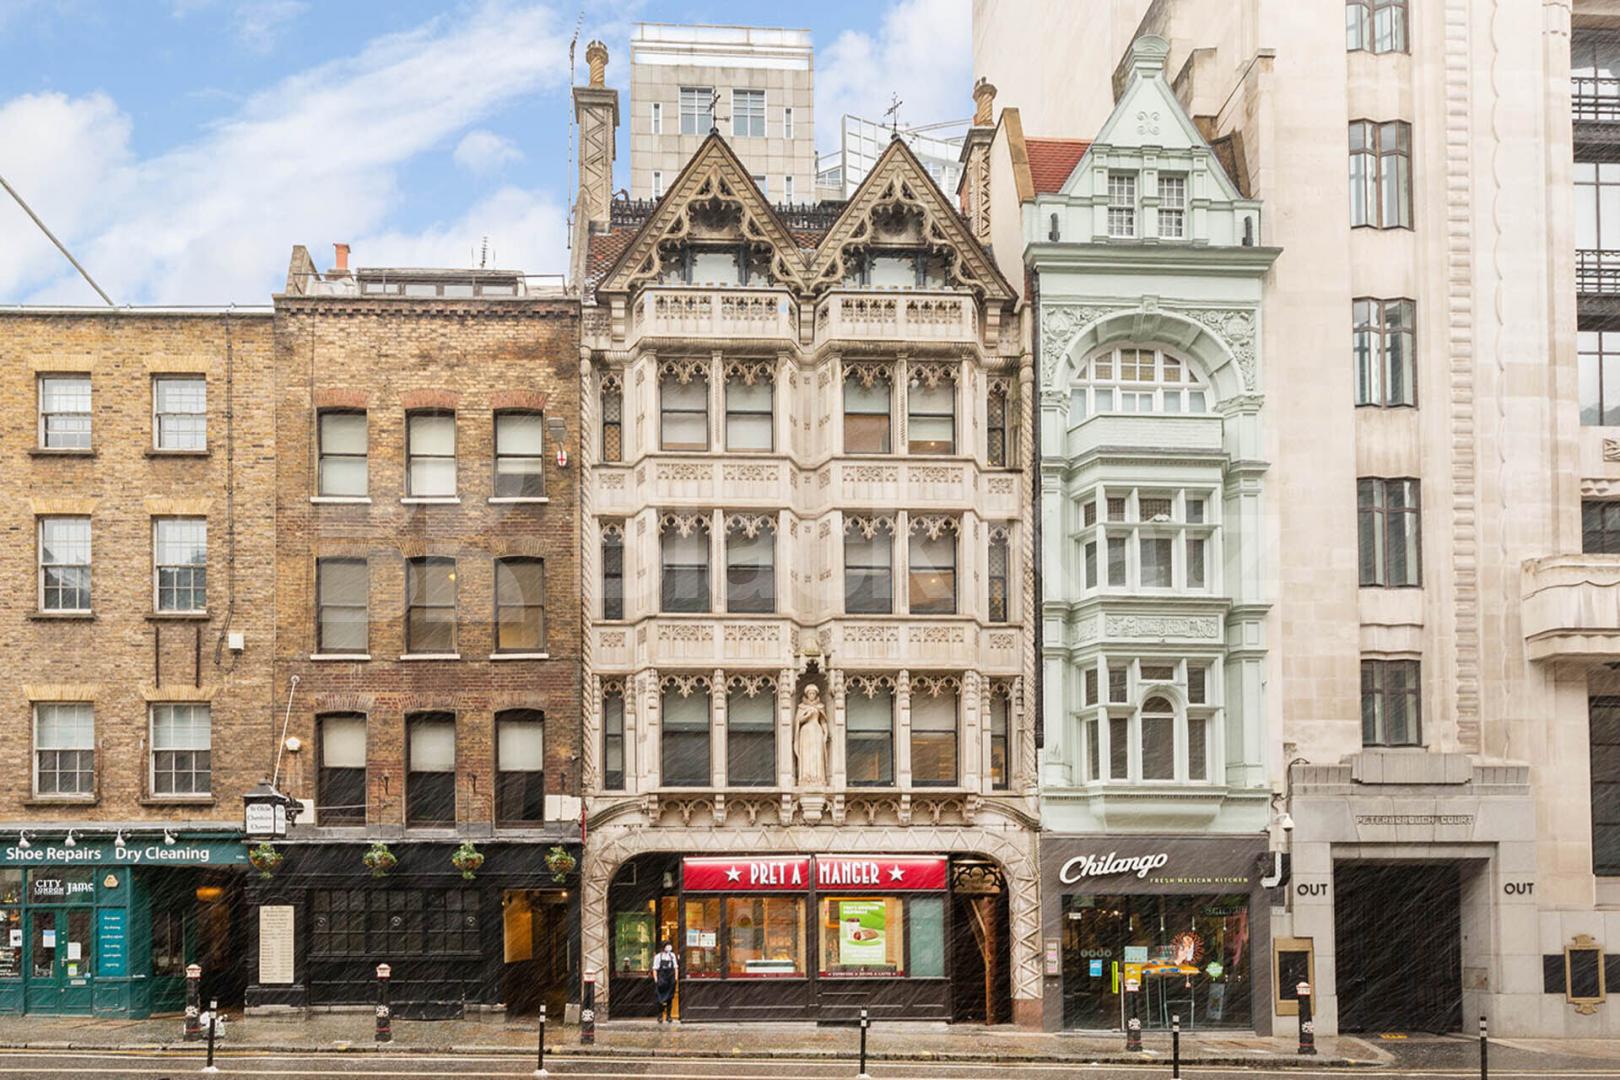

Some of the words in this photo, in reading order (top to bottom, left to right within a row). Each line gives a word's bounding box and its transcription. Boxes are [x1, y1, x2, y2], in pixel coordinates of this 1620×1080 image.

[1355, 815, 1435, 825] PETERBOROUGH
[1440, 815, 1473, 825] COURT
[6, 847, 43, 860] Shoe
[47, 847, 101, 862] Repairs
[115, 847, 142, 863] Dry
[145, 846, 210, 862] Cleaning
[751, 863, 785, 885] PRET
[791, 863, 802, 885] A
[818, 861, 880, 885] MANGER
[1060, 852, 1168, 884] Chilango
[35, 879, 61, 888] CITY
[1149, 877, 1175, 885] FRESH
[34, 887, 64, 895] LONDON
[1297, 883, 1328, 896] OUT
[1504, 882, 1534, 895] OUT
